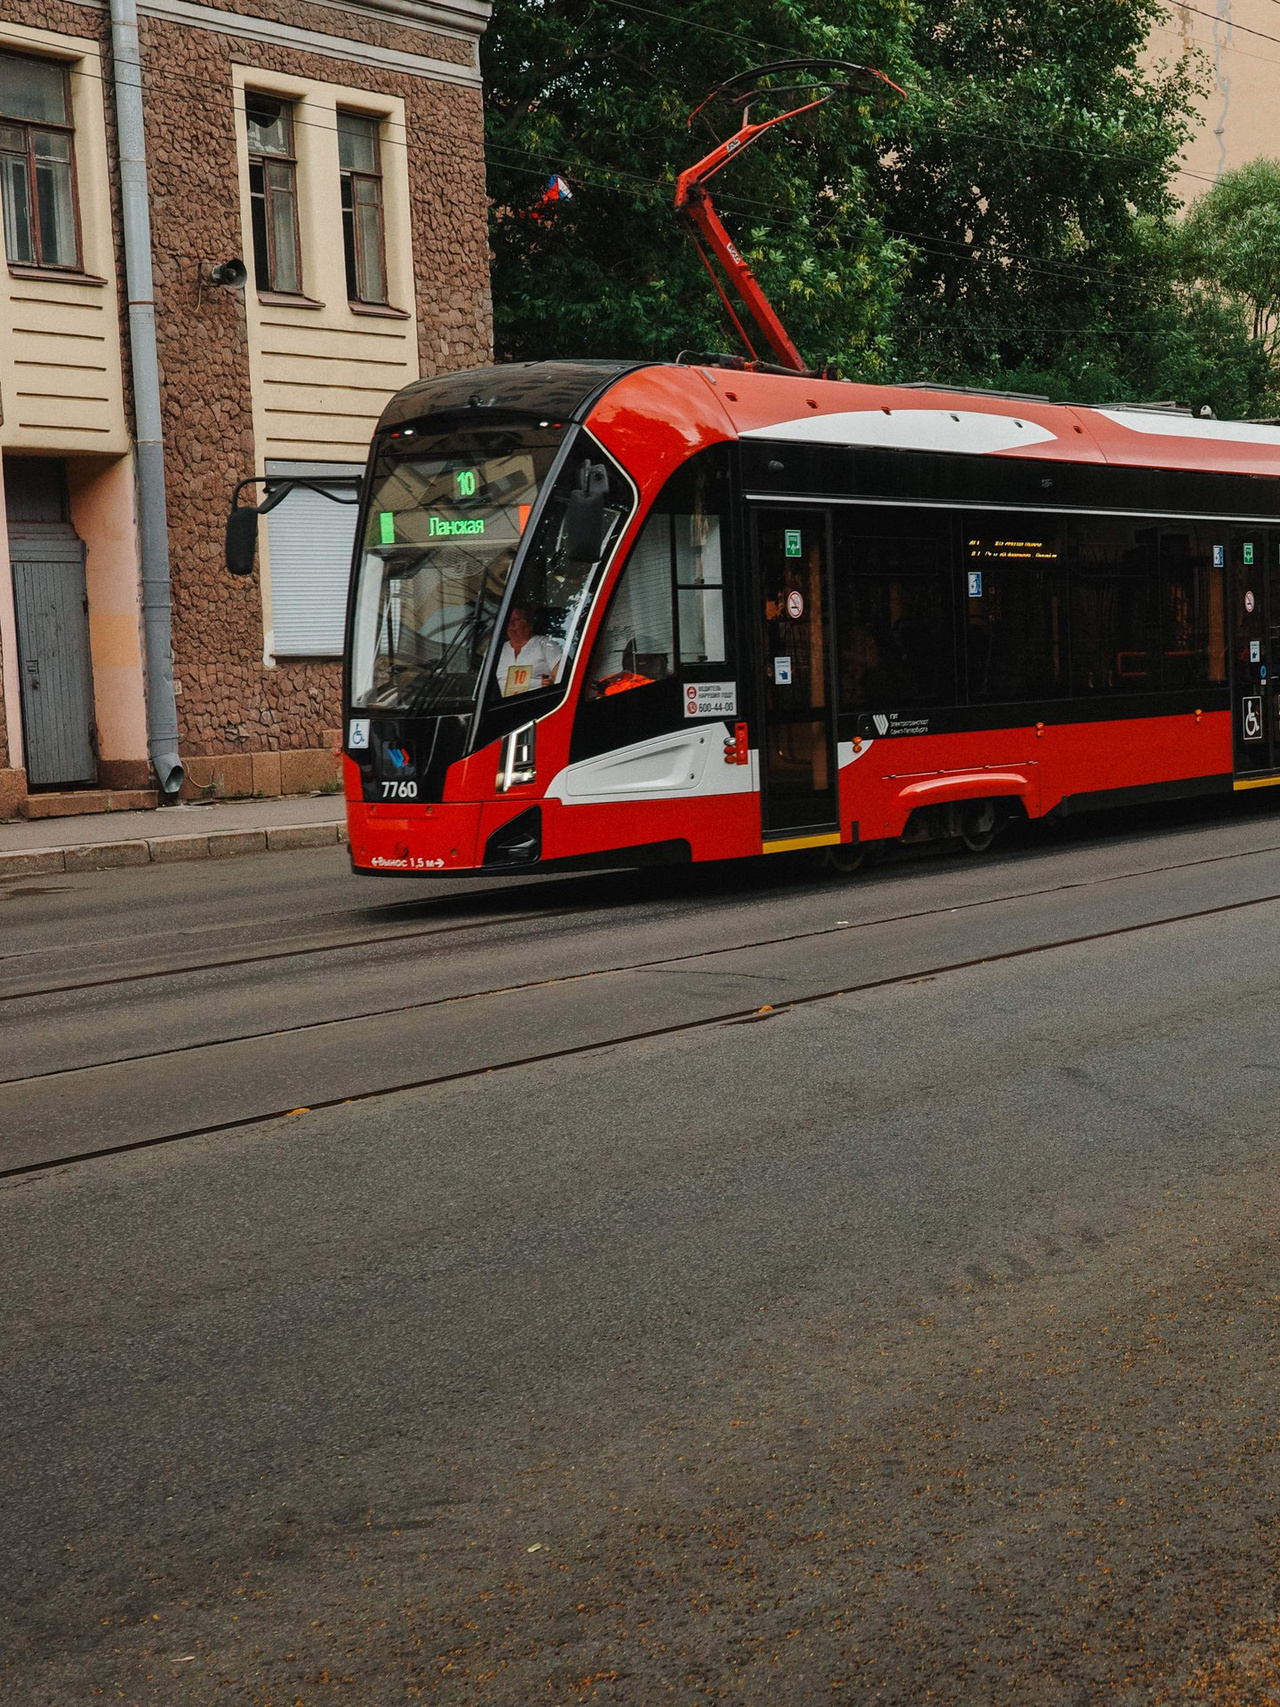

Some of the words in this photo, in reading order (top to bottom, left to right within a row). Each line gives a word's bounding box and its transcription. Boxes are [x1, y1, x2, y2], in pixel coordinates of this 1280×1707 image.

[457, 471, 476, 496] 10
[429, 517, 484, 536] Ланская
[514, 669, 527, 685] 10
[698, 702, 734, 712] 600-44-00
[381, 781, 418, 798] 7760
[410, 858, 424, 869] 1,5
